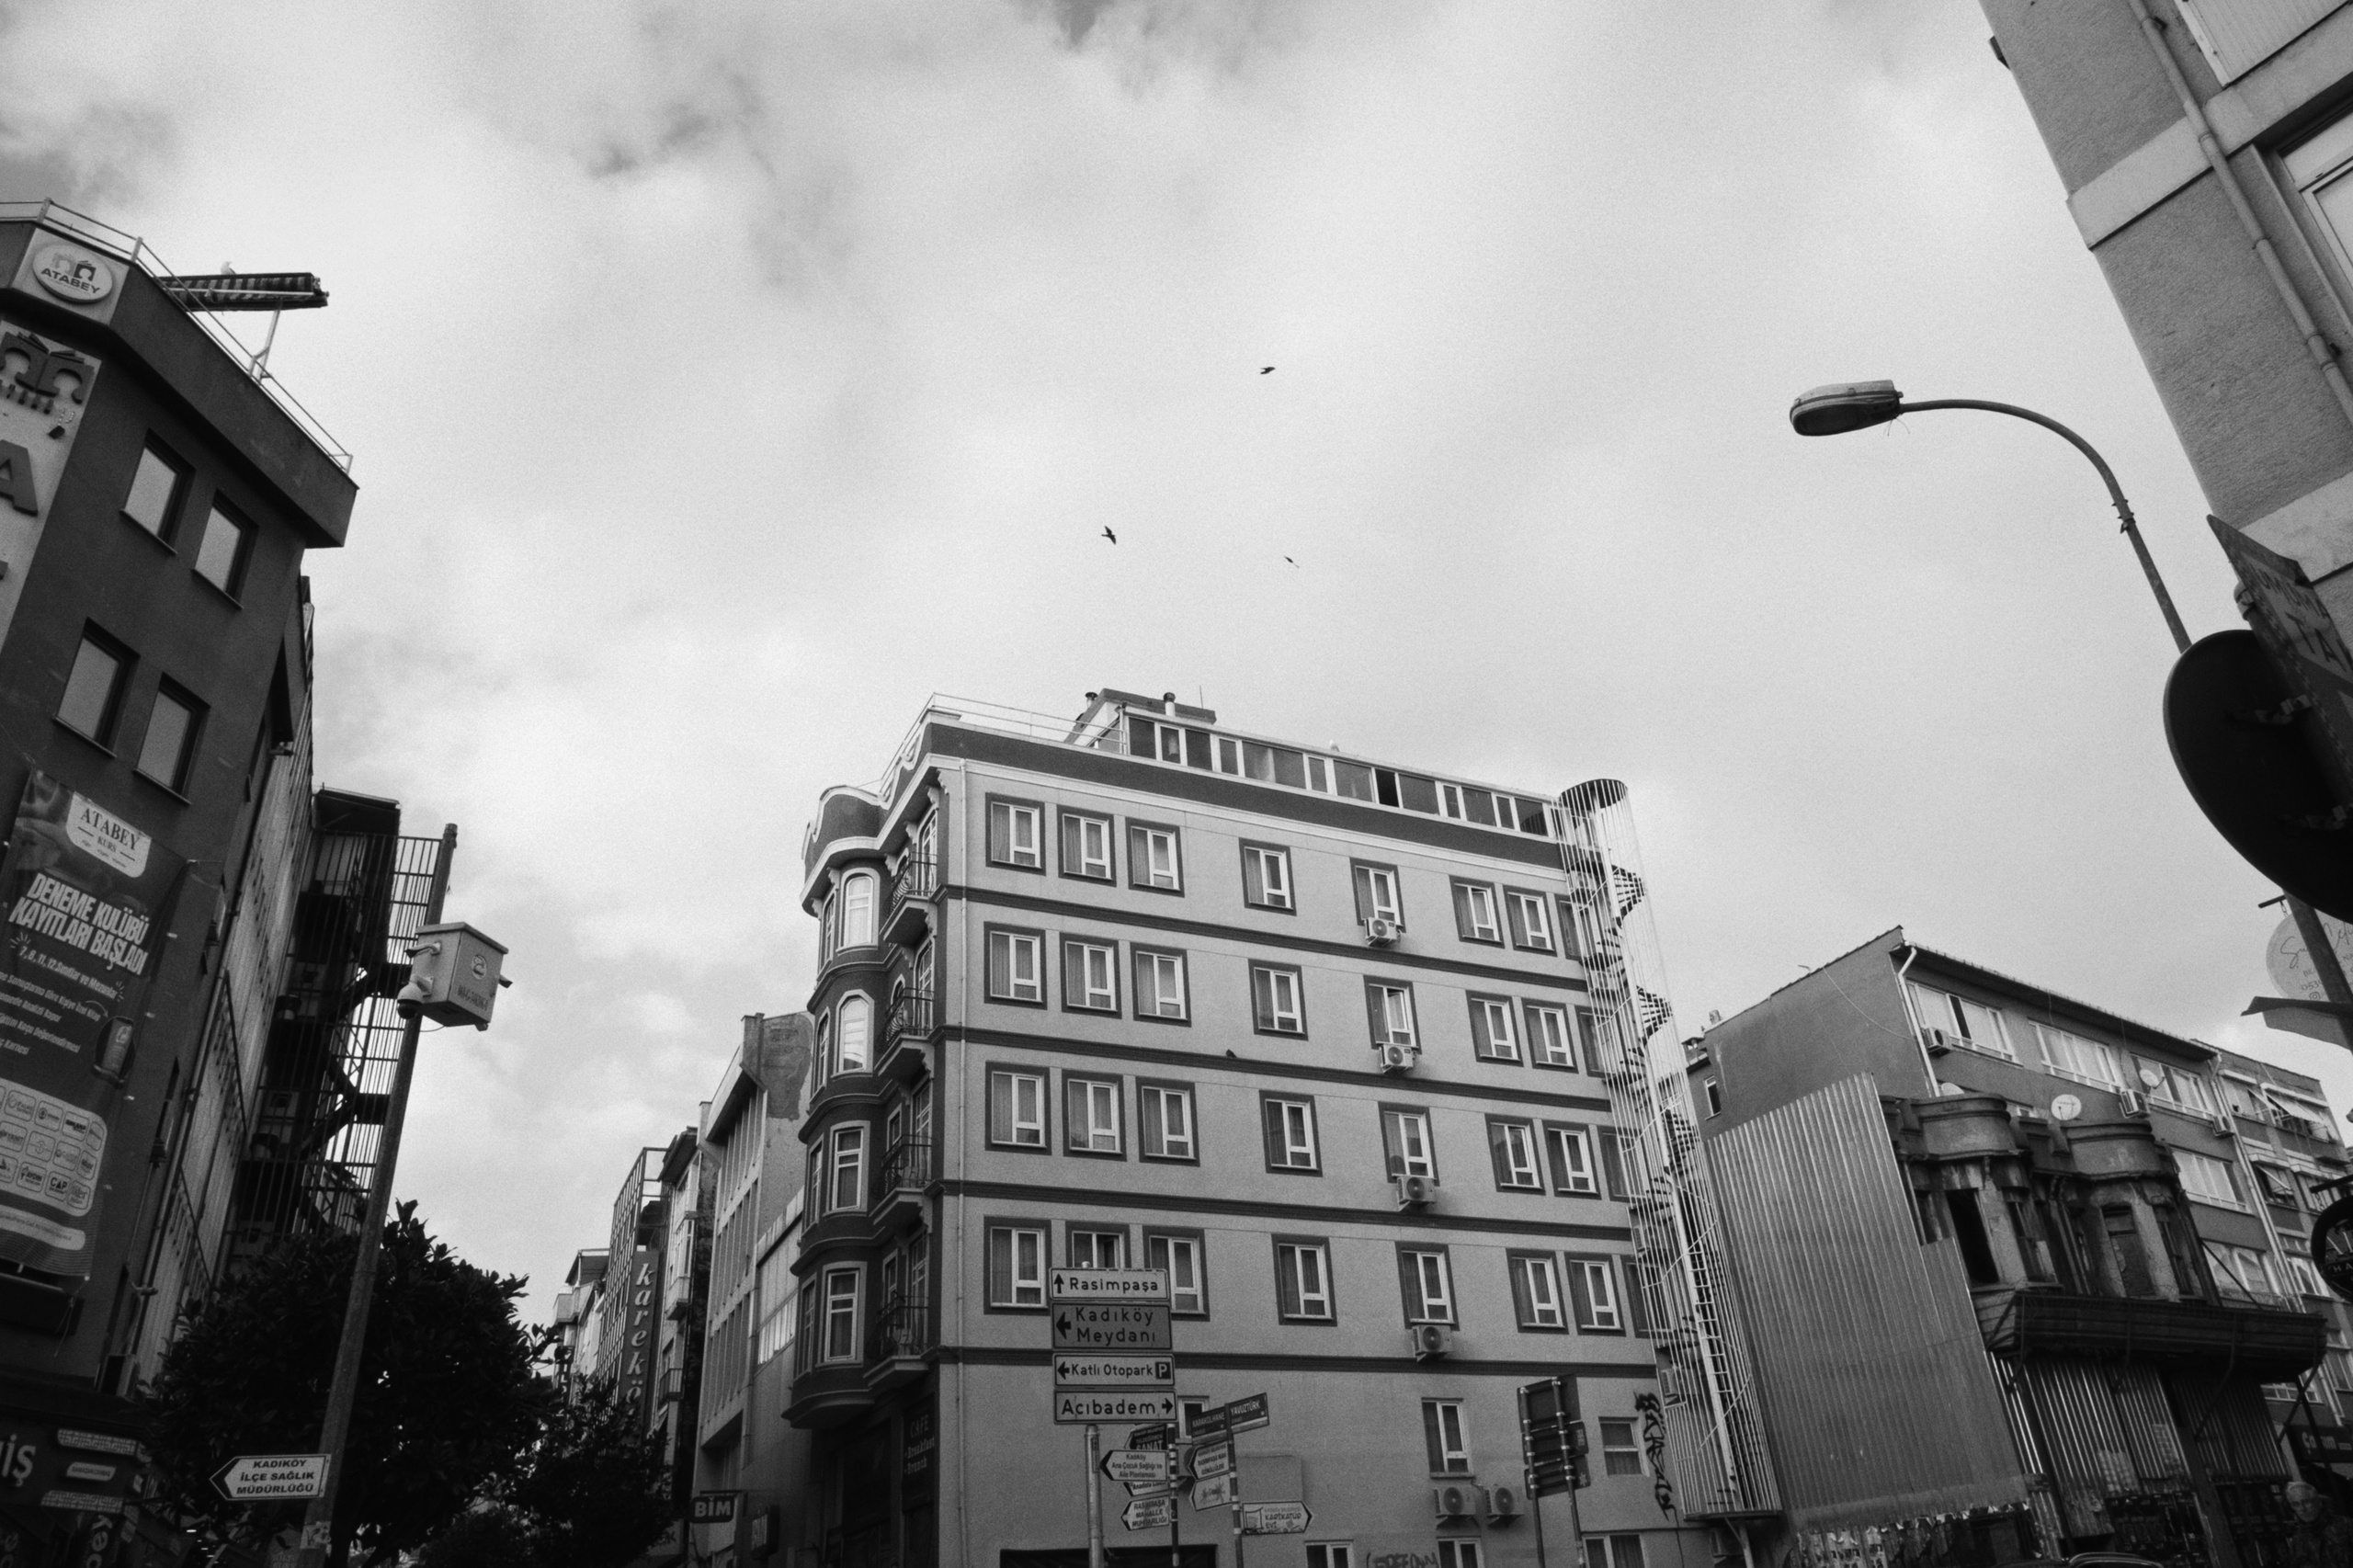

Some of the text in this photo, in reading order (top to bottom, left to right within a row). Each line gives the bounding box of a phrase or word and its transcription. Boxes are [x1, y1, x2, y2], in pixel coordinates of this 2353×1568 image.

[40, 267, 100, 294] ATABEY
[2285, 611, 2353, 673] TA
[80, 807, 141, 850] ATABEY
[97, 835, 118, 853] KURS
[27, 873, 150, 946] DENEME KULÜBÜ
[8, 897, 148, 976] KAYITLARI BAŞLADI
[1070, 1278, 1158, 1293] Rasimpaşa
[1075, 1307, 1154, 1326] Kadıköy
[626, 1263, 655, 1415] karekö
[1076, 1327, 1155, 1346] Meydanı
[1071, 1363, 1099, 1375] Katlı
[1103, 1363, 1154, 1379] Otopark
[1062, 1399, 1155, 1415] Acıbadem
[1231, 1401, 1260, 1415] YAVUZTÜRK
[910, 1415, 929, 1438] CAFE
[1192, 1412, 1225, 1427] KARAKOLHANE
[907, 1435, 935, 1459] Breakfast
[253, 1458, 308, 1469] KADIKÖY
[907, 1455, 926, 1475] Brunch
[241, 1470, 315, 1483] İLÇE SAĞLIK
[237, 1482, 314, 1494] MÜDÜRLÜĞÜ
[695, 1497, 731, 1517] BİM
